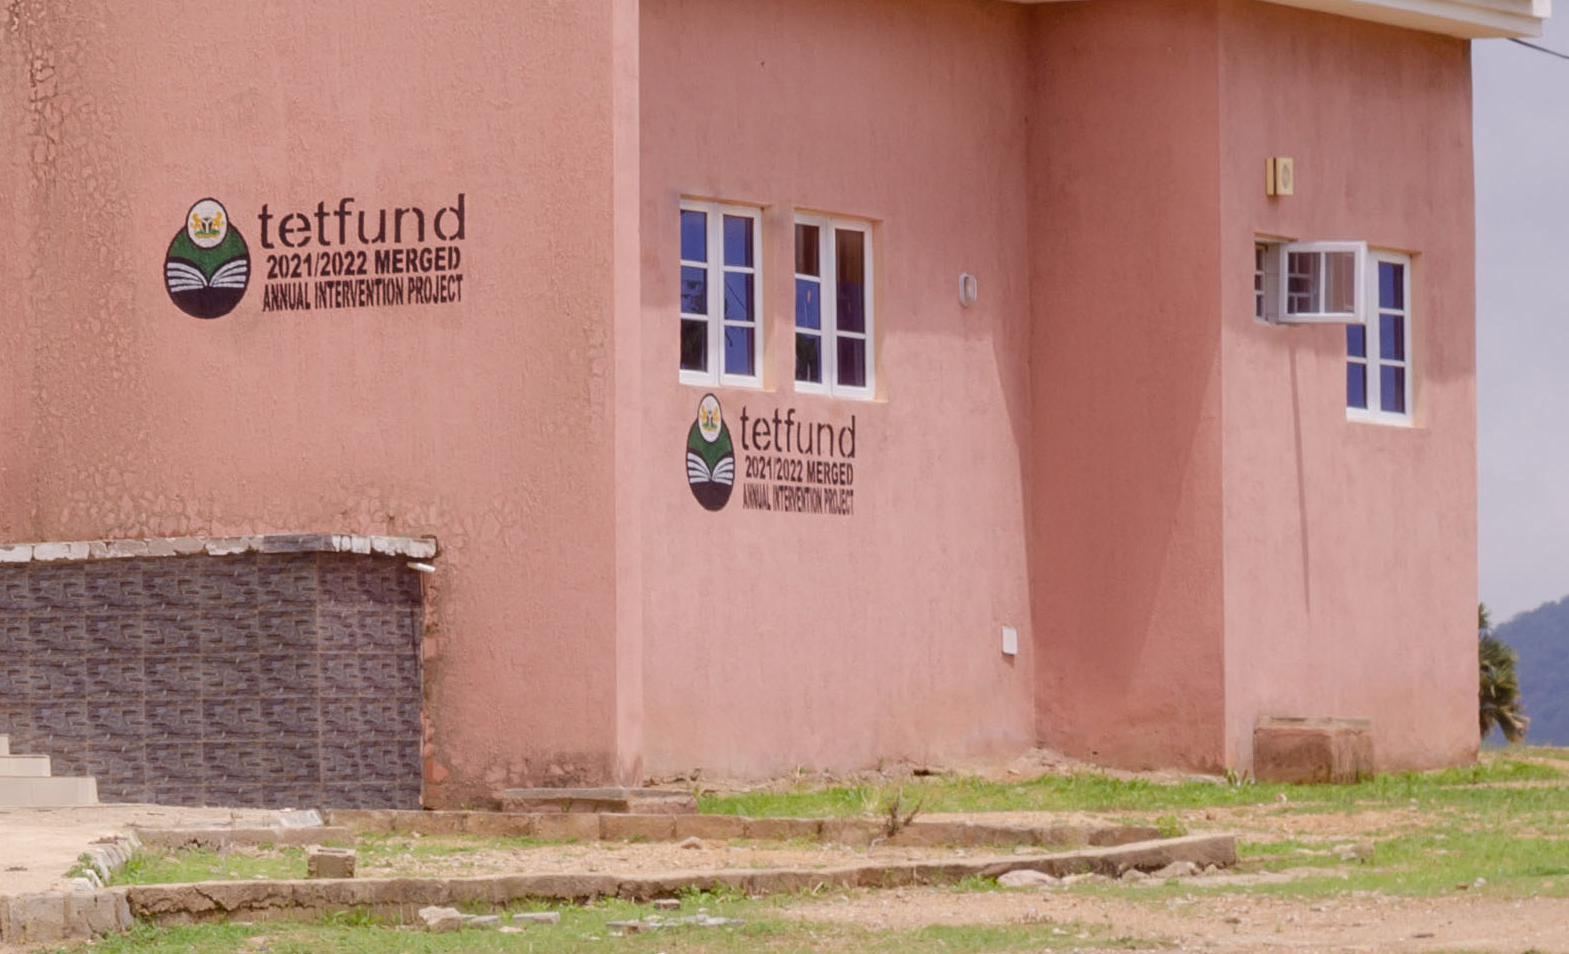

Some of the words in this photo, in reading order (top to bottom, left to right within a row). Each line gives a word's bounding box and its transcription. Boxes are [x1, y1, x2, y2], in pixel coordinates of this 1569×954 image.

[257, 193, 466, 250] tetfund
[266, 250, 368, 280] 2021/2022
[374, 246, 462, 275] MERGED
[262, 281, 311, 312] ANNUAL
[314, 276, 404, 310] INTERVENTION
[407, 273, 464, 305] PROJECT
[739, 406, 856, 459] tetfund
[745, 455, 804, 483] 2021/2022
[806, 460, 854, 486] MERGED
[742, 483, 771, 510] ANNUAL
[772, 484, 823, 514] INTERVENTION
[823, 488, 854, 516] PROJECT
